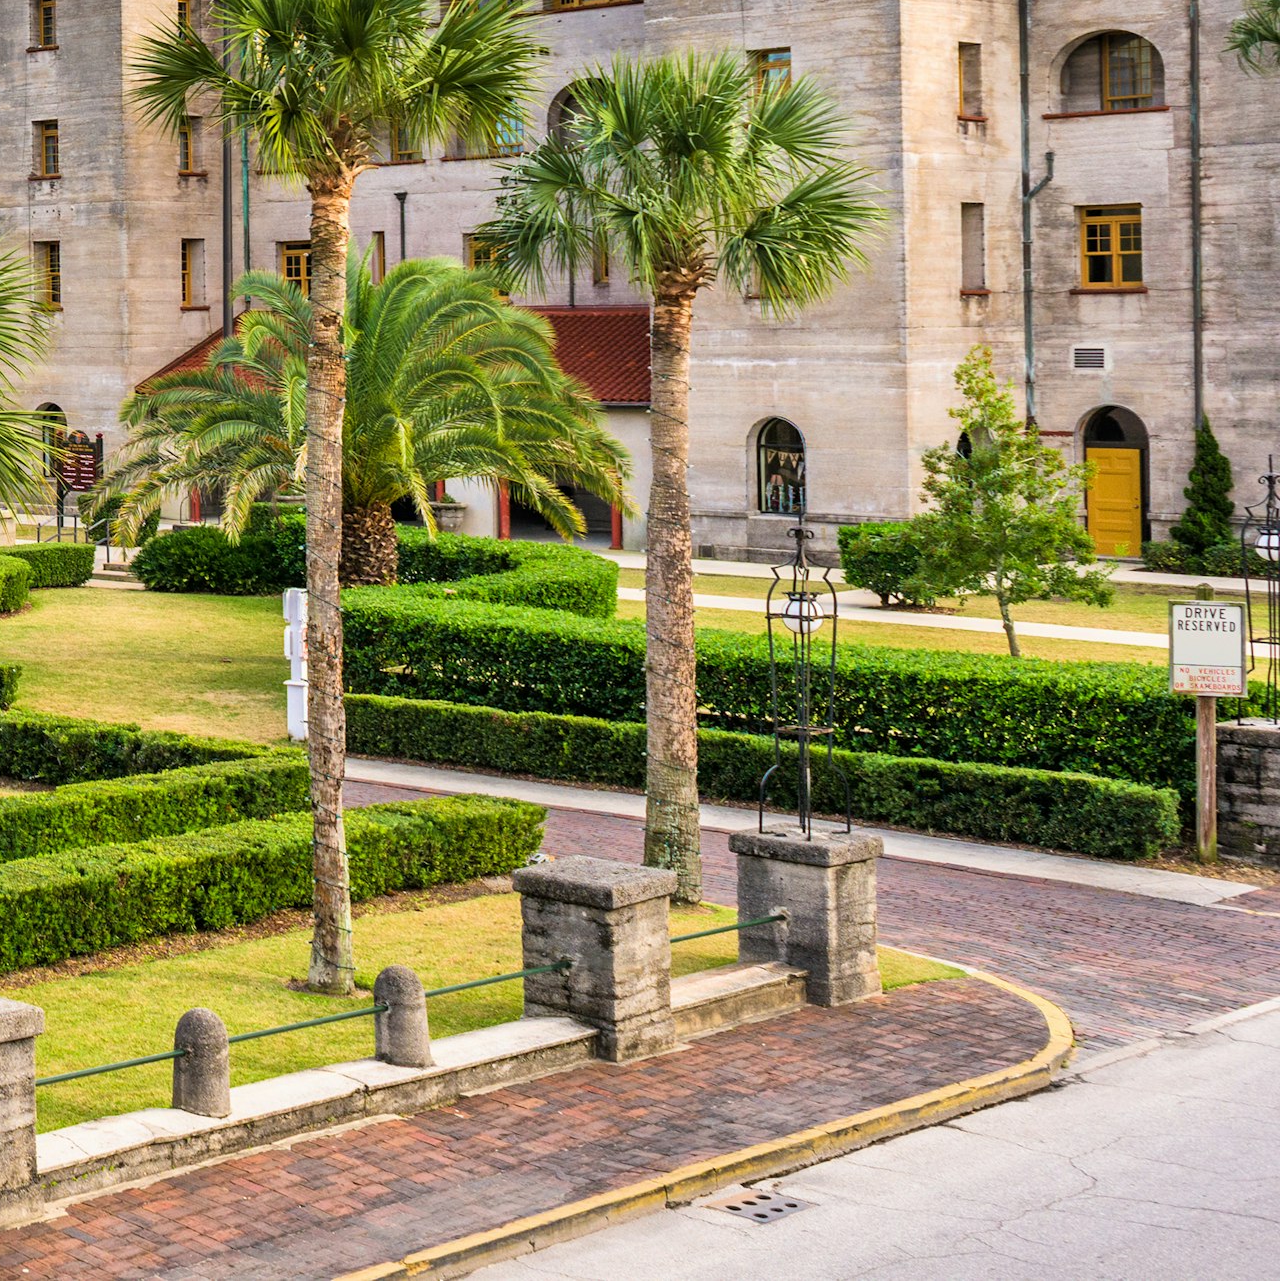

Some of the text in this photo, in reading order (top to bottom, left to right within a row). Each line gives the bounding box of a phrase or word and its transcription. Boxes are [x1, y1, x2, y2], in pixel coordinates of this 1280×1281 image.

[1185, 607, 1227, 619] DRIVE
[1178, 620, 1236, 632] RESERVED
[1198, 668, 1236, 676] VEHICLES
[1189, 675, 1227, 683] BICYCLES
[1190, 683, 1241, 691] SKATEBOARDS
